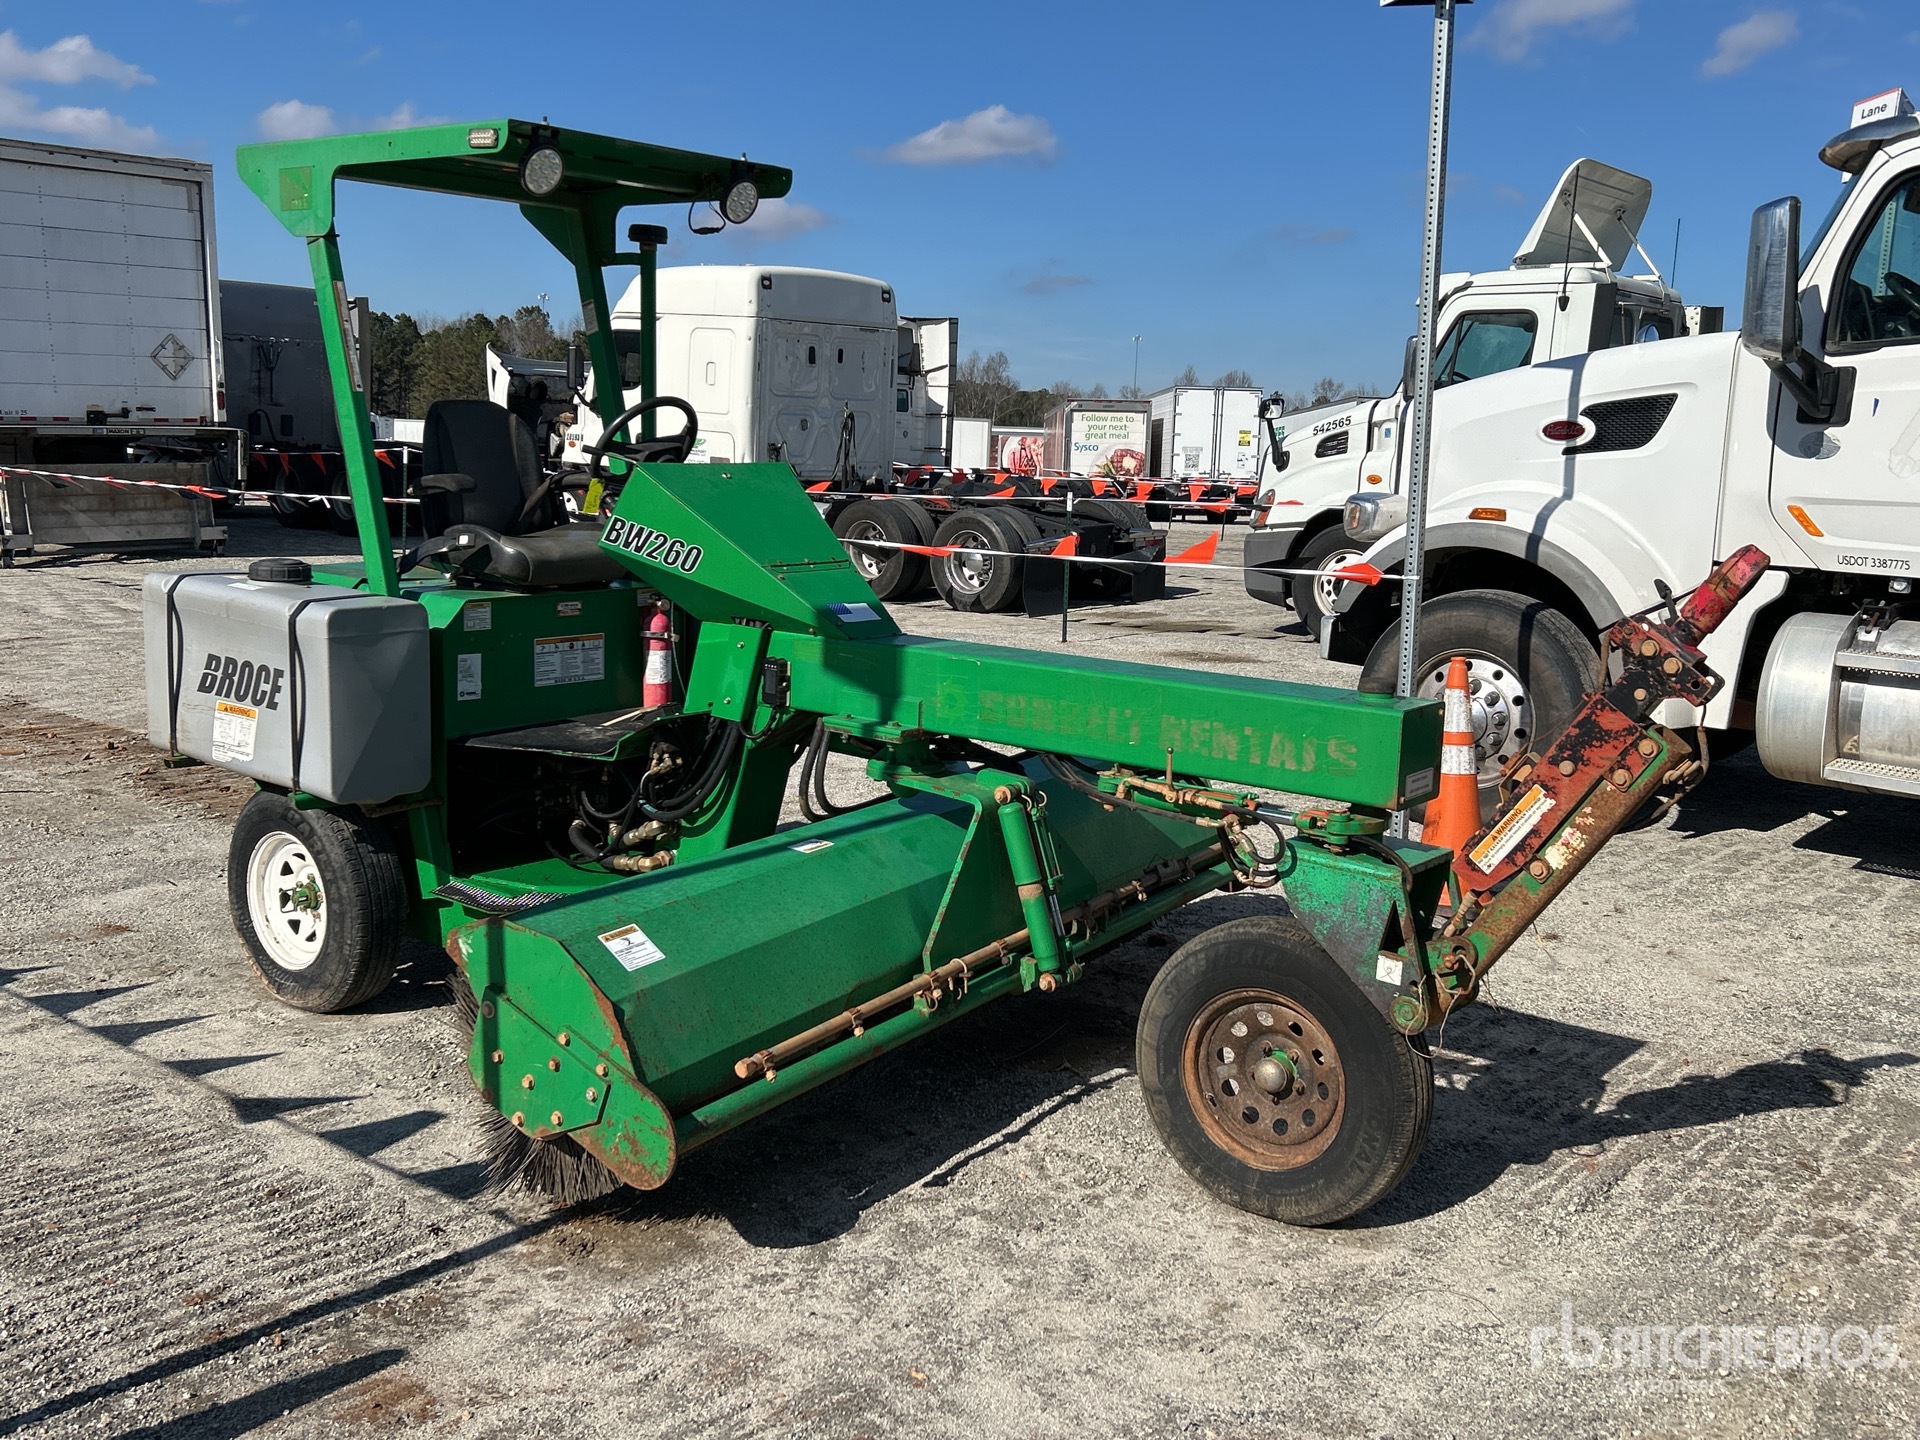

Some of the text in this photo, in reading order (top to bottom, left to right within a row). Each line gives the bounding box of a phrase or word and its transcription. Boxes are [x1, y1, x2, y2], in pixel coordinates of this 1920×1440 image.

[1861, 103, 1887, 119] Lane
[1081, 413, 1109, 422] Follow
[1125, 415, 1135, 423] to
[1312, 415, 1352, 436] 542565
[1085, 431, 1130, 441] great meal
[1087, 424, 1107, 432] your
[1073, 442, 1099, 453] Sysco
[602, 515, 704, 574] BW260
[1837, 554, 1911, 571] USDOT 3387775
[197, 653, 284, 711] BROCE
[1495, 808, 1522, 835] WARNING
